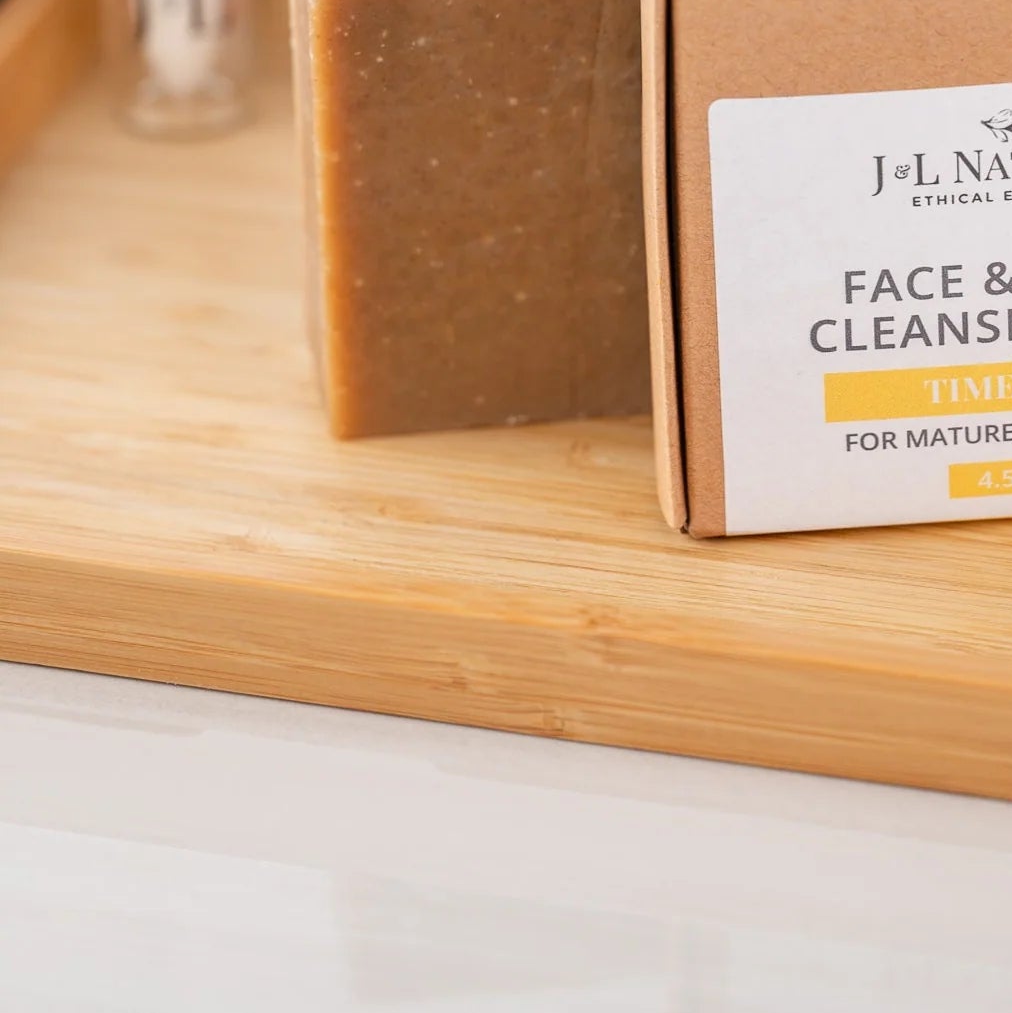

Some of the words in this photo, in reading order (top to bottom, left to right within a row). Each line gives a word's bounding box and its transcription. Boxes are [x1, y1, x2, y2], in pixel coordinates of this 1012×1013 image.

[912, 194, 994, 207] ETHICAL
[844, 264, 964, 305] FACE
[845, 431, 898, 452] FOR
